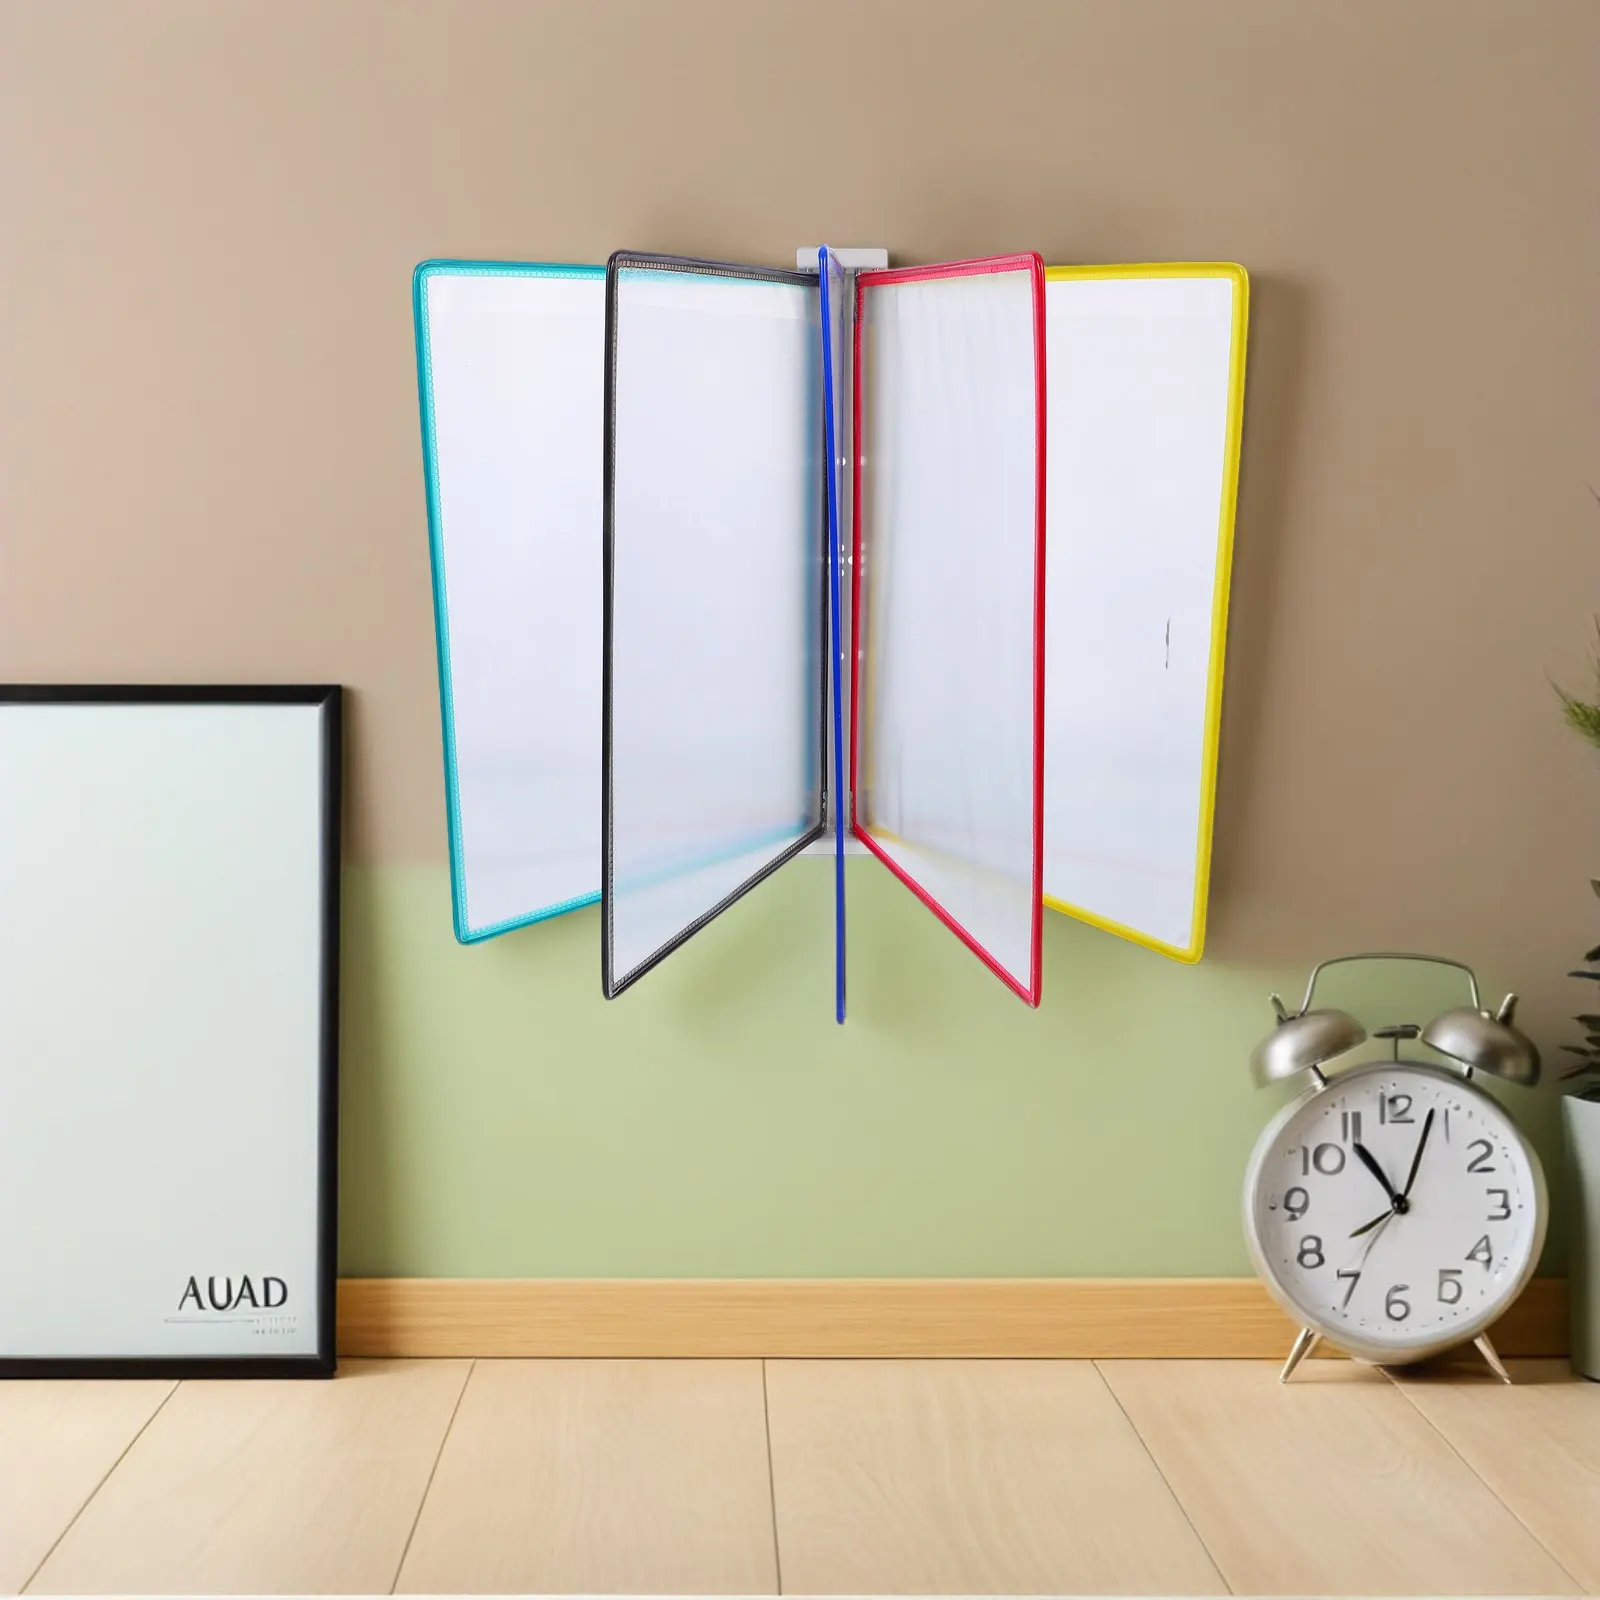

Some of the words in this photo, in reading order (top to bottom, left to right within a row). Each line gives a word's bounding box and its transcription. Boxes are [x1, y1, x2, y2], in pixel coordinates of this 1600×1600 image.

[1380, 1093, 1415, 1125] 12
[1341, 1111, 1362, 1143] 11
[1301, 1142, 1346, 1176] 10
[1466, 1139, 1496, 1174] 2
[1283, 1186, 1310, 1222] 9
[1486, 1188, 1512, 1221] 3
[1296, 1234, 1325, 1269] 8
[178, 1274, 288, 1311] AUAD
[1337, 1268, 1361, 1309] 7
[1385, 1284, 1410, 1321] 6
[1438, 1269, 1463, 1304] 5
